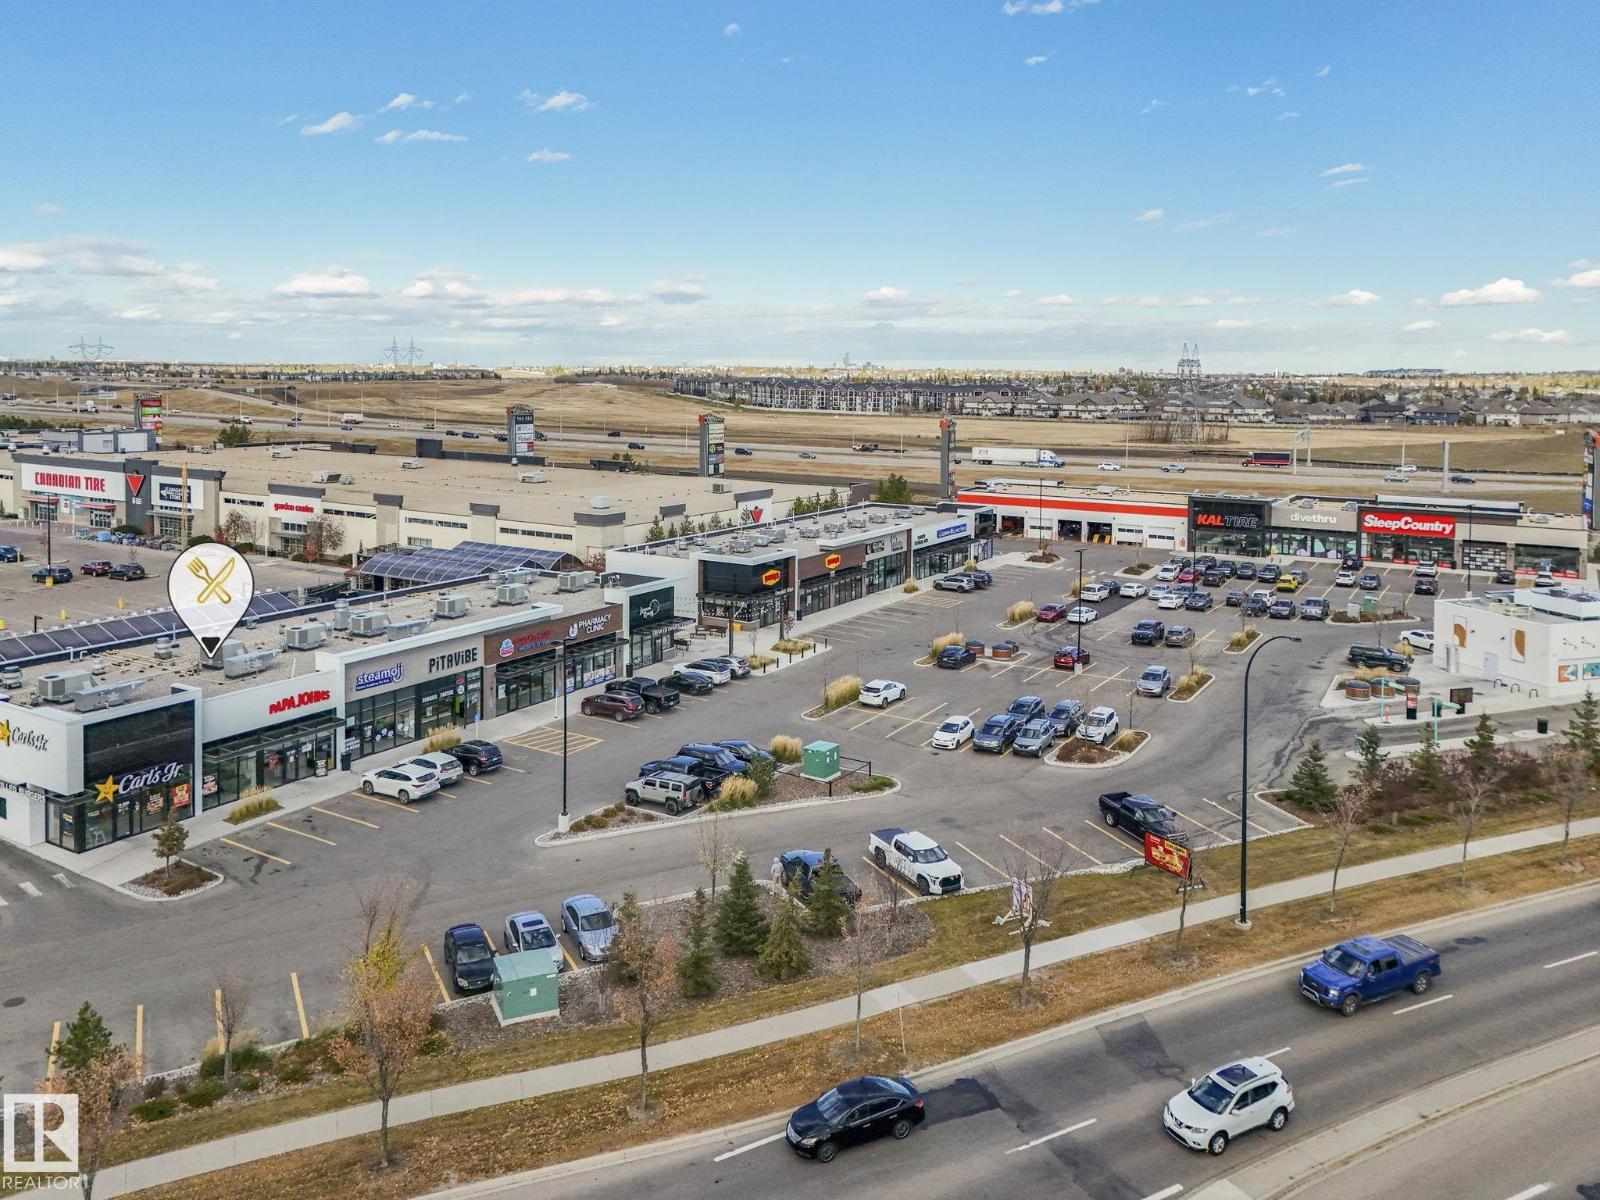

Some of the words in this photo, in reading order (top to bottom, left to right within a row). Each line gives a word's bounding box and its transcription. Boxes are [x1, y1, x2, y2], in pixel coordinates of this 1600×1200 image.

[34, 471, 81, 490] CANADIAN
[84, 476, 105, 492] TIRE
[274, 502, 294, 512] garden
[1197, 514, 1225, 526] KAL
[1225, 516, 1258, 528] TIRE
[1290, 513, 1337, 524] divethru
[578, 614, 612, 629] PHARMACY
[586, 625, 605, 634] CLINIC
[269, 696, 296, 714] PAPA
[296, 690, 331, 708] JOHNS
[119, 766, 161, 794] Carl's
[162, 761, 183, 782] Jr.
